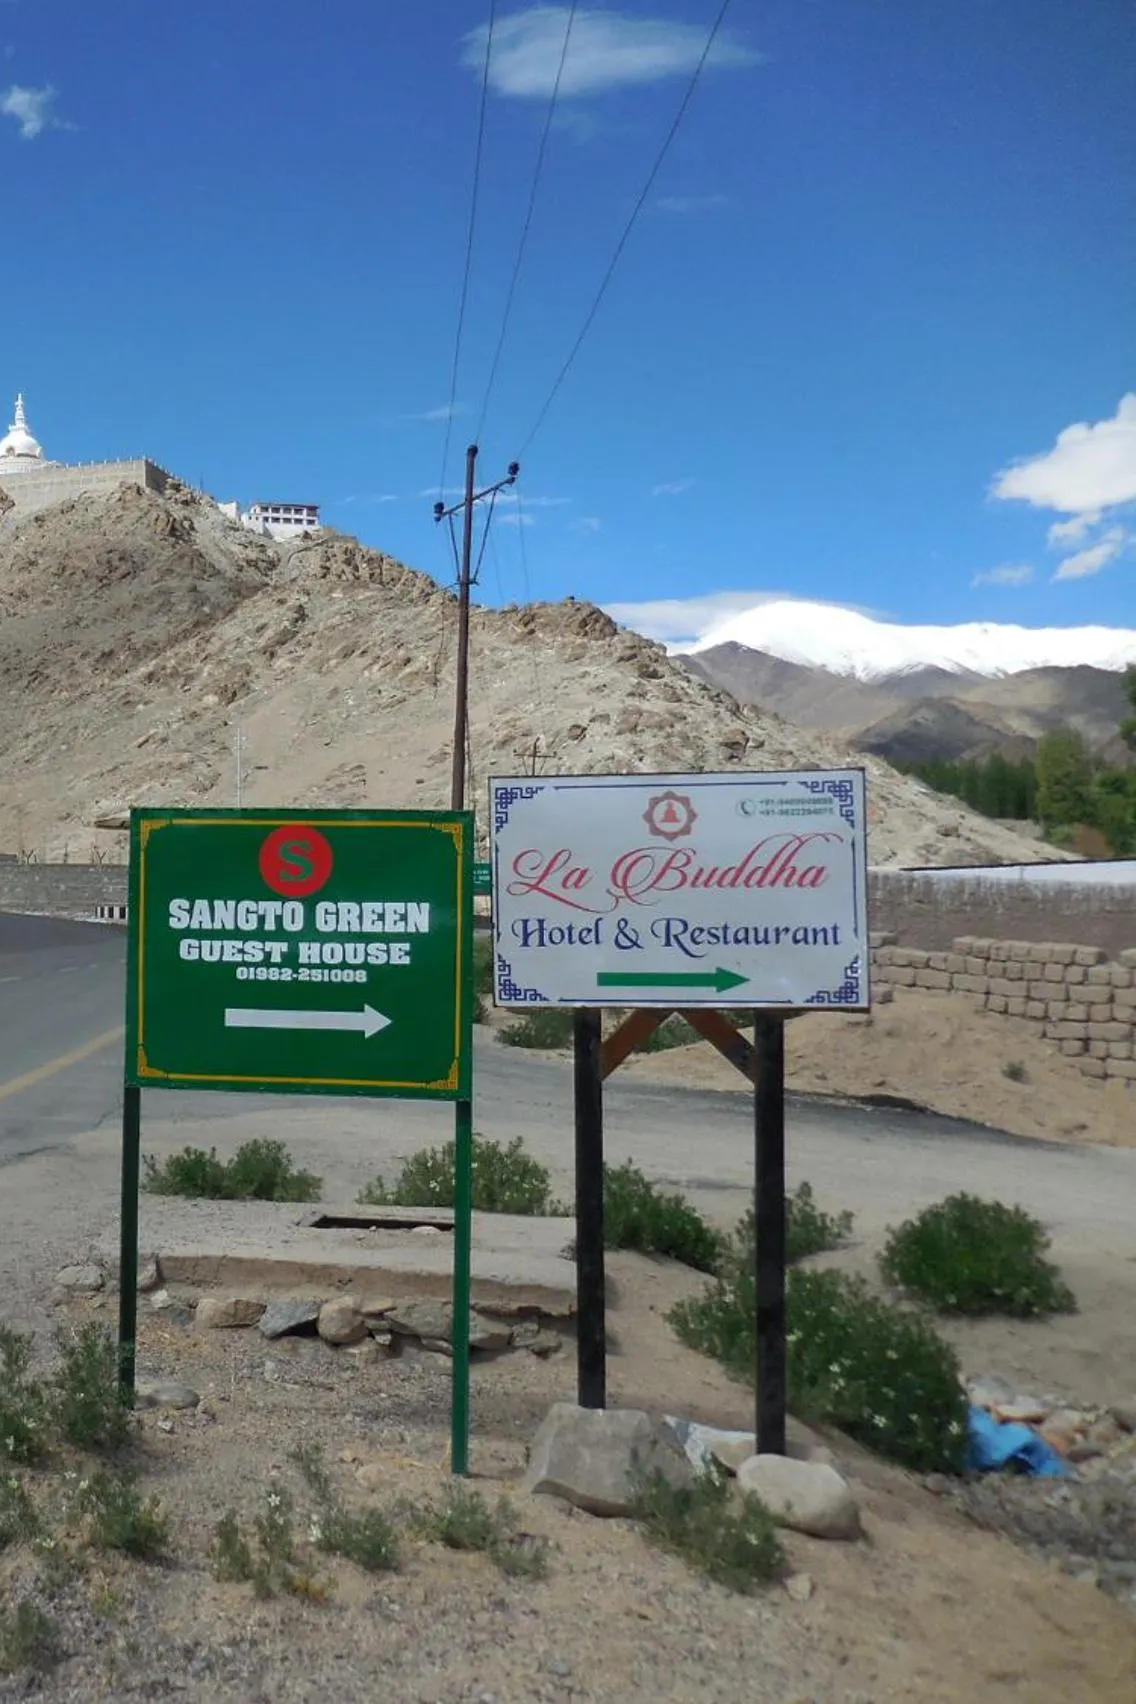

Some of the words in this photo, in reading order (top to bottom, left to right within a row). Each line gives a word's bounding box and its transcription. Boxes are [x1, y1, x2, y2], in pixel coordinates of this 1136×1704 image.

[277, 840, 313, 882] S
[506, 849, 619, 914] La
[606, 832, 844, 906] Buddha
[168, 898, 304, 932] SANGTO
[315, 902, 430, 933] GREEN
[179, 938, 288, 963] GUEST
[298, 942, 411, 964] HOUSE
[511, 917, 604, 948] Hotel
[614, 917, 645, 950] &
[651, 917, 841, 959] Restaurant
[235, 966, 367, 983] 01982-251008
